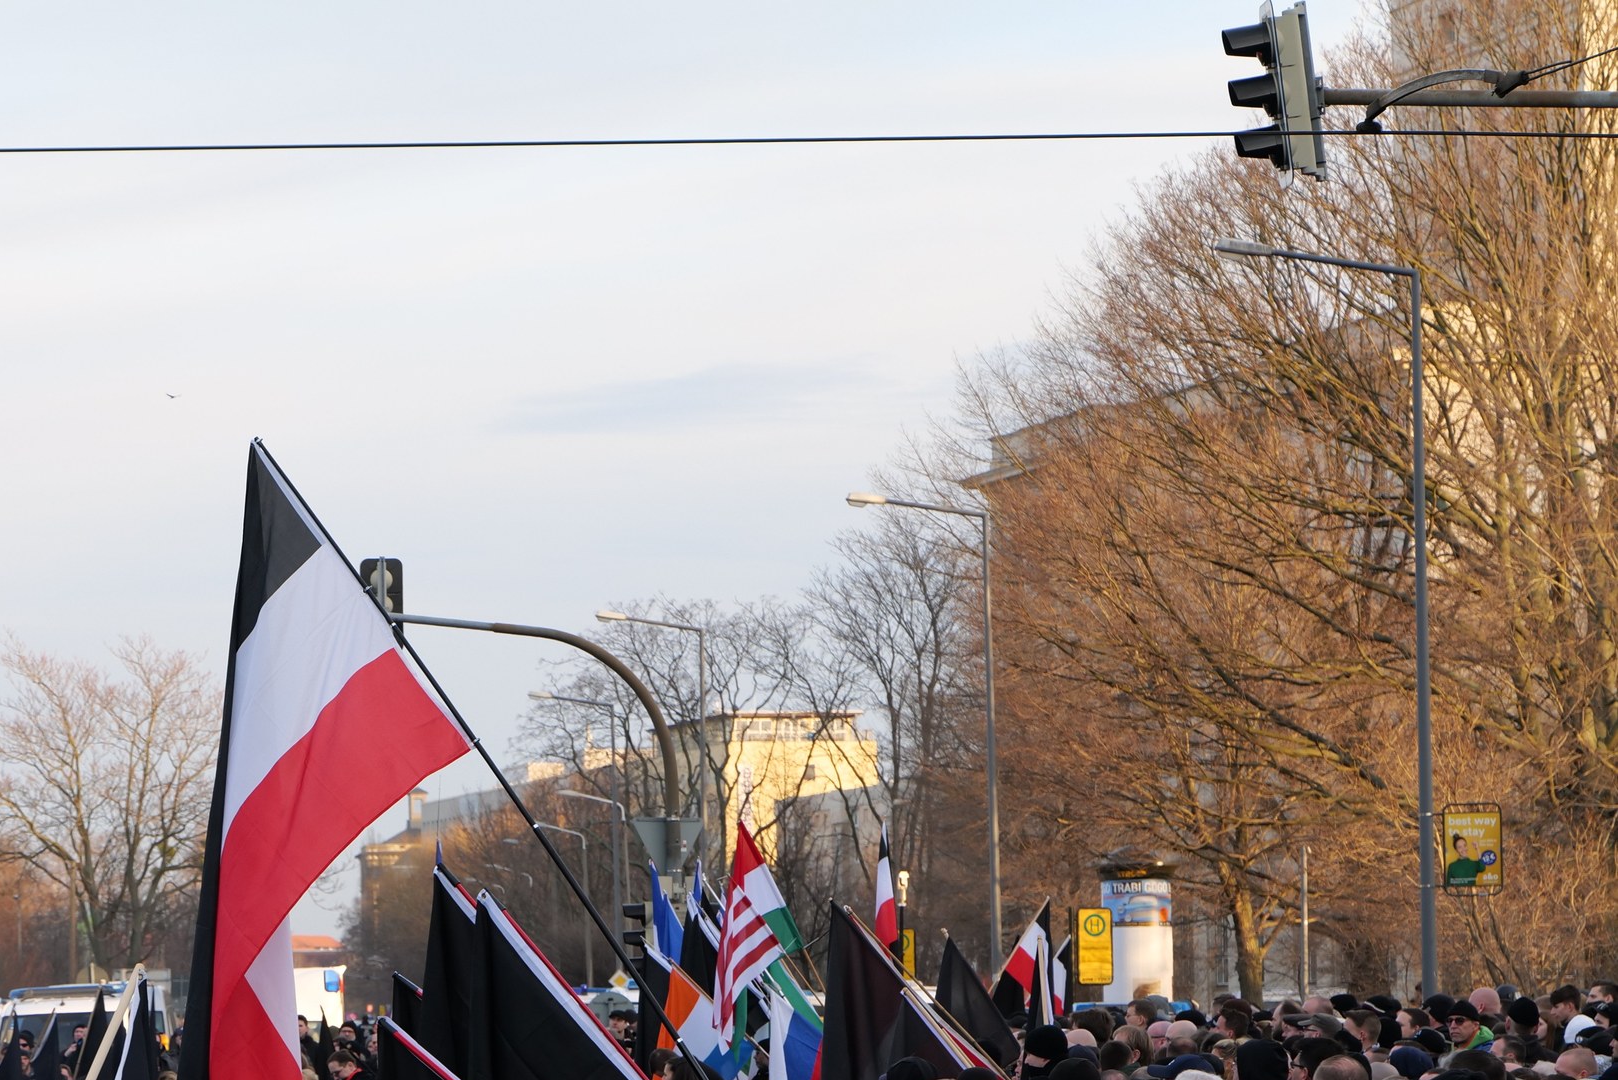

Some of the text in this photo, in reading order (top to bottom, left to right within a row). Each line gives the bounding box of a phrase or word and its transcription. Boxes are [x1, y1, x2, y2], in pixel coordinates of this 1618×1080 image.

[1448, 816, 1497, 828] best way
[1463, 828, 1485, 838] stay
[1113, 882, 1142, 894] TRABI
